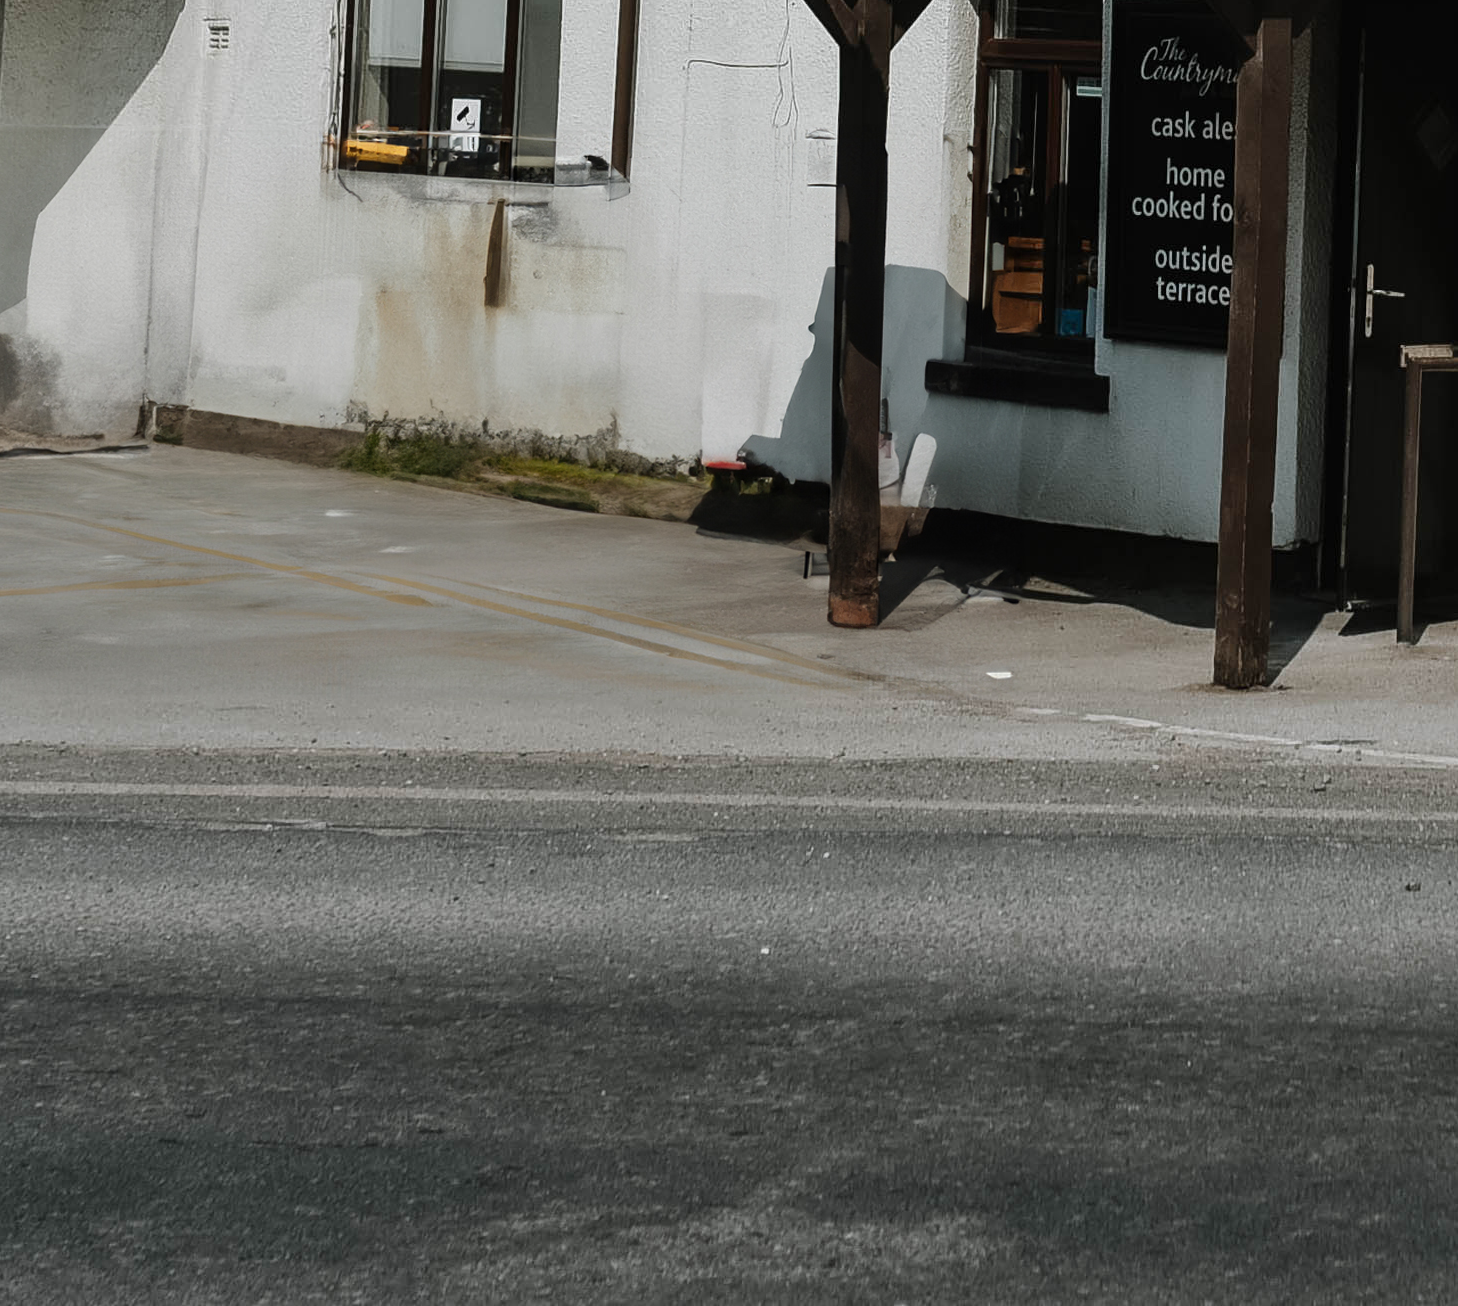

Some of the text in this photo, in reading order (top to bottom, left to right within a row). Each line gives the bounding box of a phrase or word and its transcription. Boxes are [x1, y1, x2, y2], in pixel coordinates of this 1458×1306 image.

[1160, 36, 1186, 61] The
[1151, 110, 1237, 140] cask ale
[1166, 157, 1226, 188] home
[1132, 190, 1206, 220] cooked
[1155, 245, 1234, 274] outside
[1156, 276, 1231, 306] terrace
